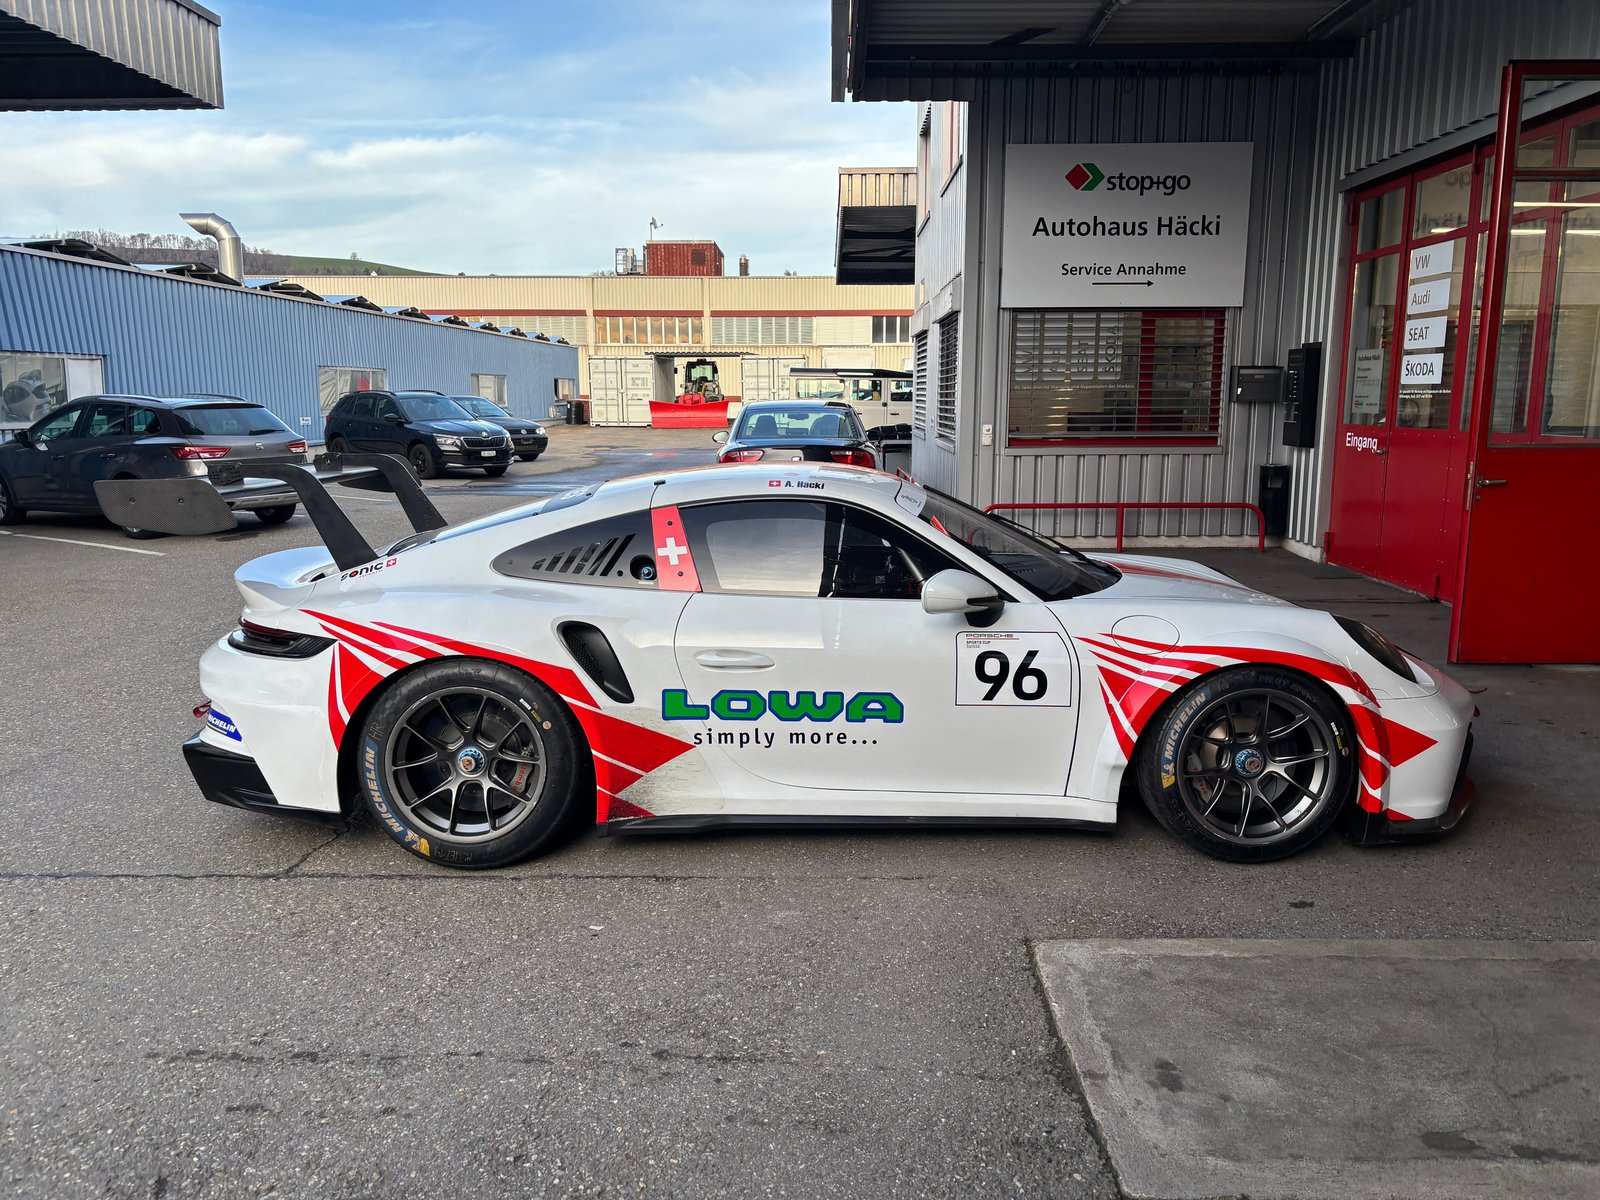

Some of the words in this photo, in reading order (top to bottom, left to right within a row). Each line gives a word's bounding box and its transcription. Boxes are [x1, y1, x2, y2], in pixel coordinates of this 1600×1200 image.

[1106, 172, 1191, 196] stop+go
[1032, 215, 1148, 237] Autohaus
[1157, 214, 1221, 236] Häcki
[1061, 263, 1112, 276] Service
[1116, 262, 1187, 276] Annahme
[1415, 253, 1431, 270] VW
[1411, 290, 1431, 306] Audi
[1408, 326, 1430, 341] SEAT
[1405, 360, 1434, 377] ŠKODA
[1345, 432, 1378, 453] Eingang
[974, 649, 1048, 701] 96
[662, 689, 904, 723] LOWA
[1164, 692, 1207, 760] MICHELIN
[693, 728, 775, 748] simply
[789, 730, 878, 746] more...
[365, 745, 404, 833] MICHELIN
